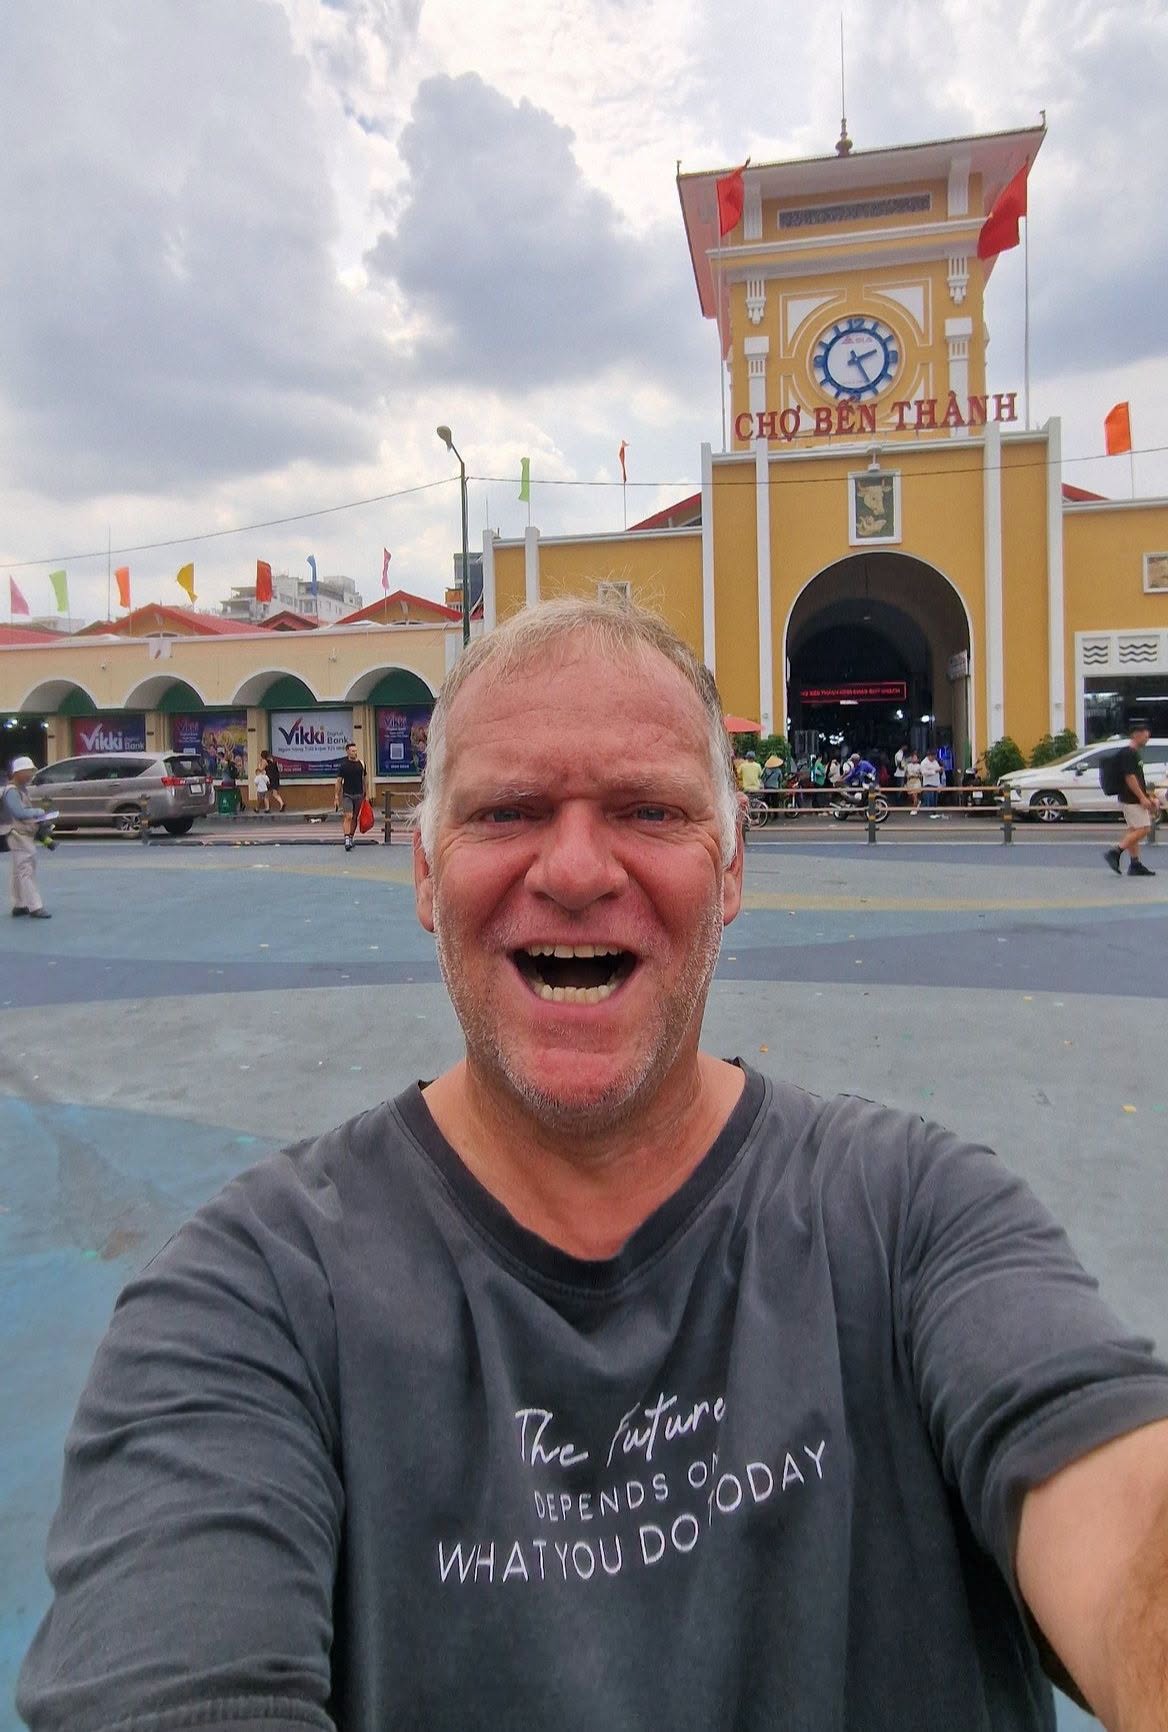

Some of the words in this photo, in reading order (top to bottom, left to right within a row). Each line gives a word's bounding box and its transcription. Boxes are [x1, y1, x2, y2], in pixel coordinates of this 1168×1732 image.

[734, 405, 801, 443] CHỢ
[813, 396, 877, 437] BẾN
[890, 390, 1018, 432] THÀNH
[79, 722, 123, 751] Vikki
[278, 716, 325, 745] Vikki
[514, 1408, 589, 1468] The
[606, 1392, 726, 1469] Future
[533, 1472, 669, 1522] DEPENDS
[638, 1513, 699, 1566] DO
